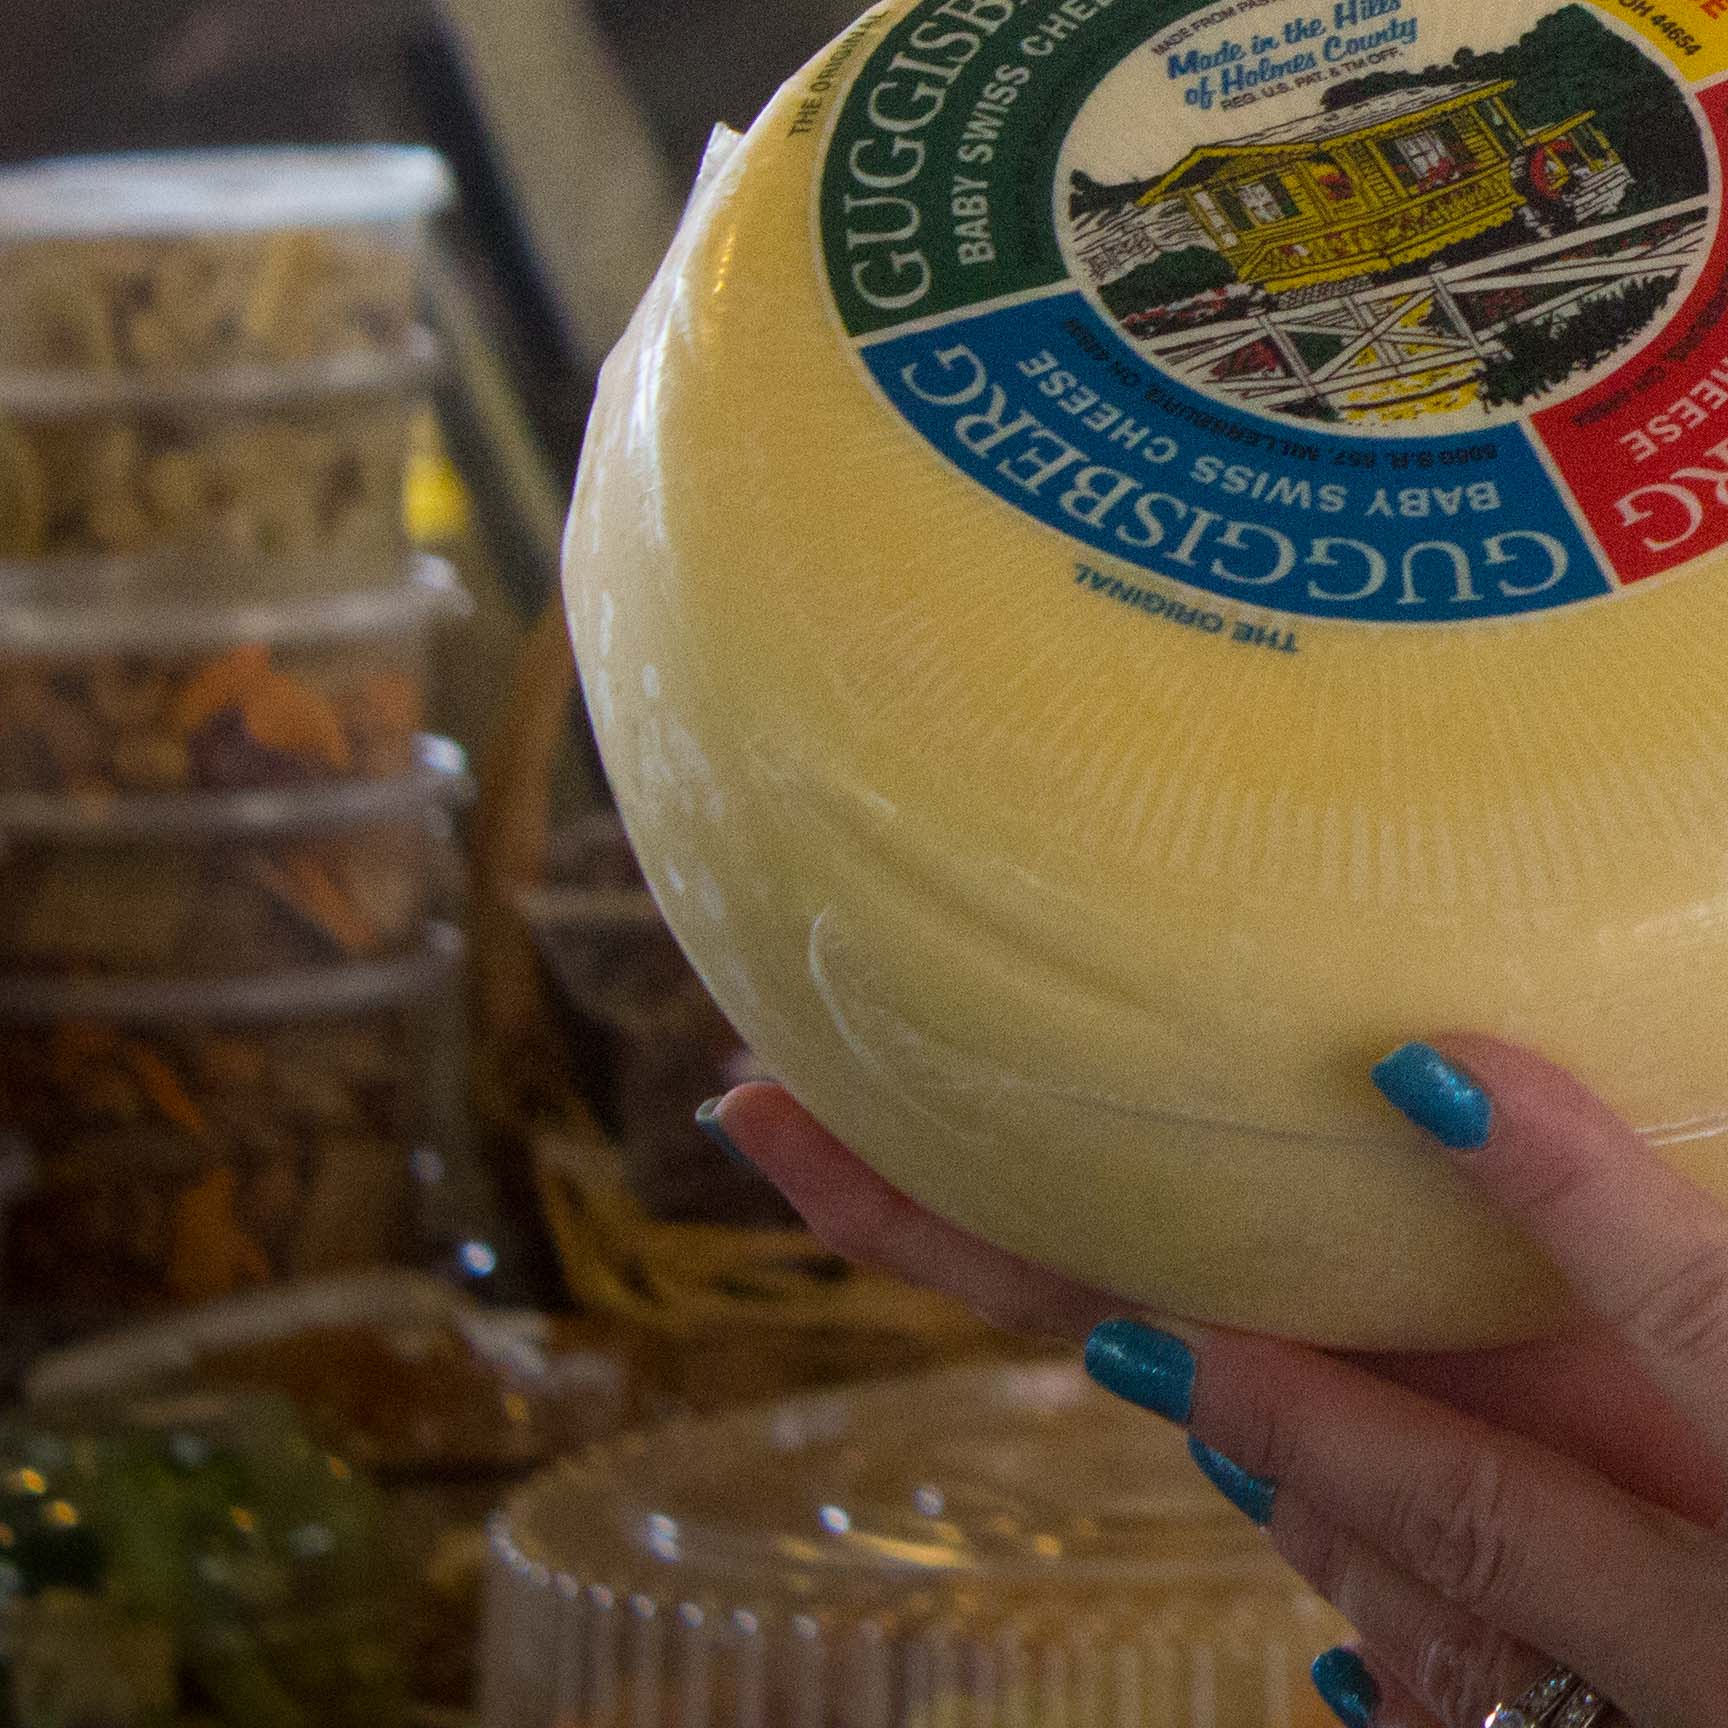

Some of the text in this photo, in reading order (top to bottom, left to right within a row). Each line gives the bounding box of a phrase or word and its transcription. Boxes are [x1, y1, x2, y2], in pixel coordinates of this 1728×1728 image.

[1151, 28, 1193, 56] MADE
[1191, 7, 1237, 32] FROM
[1168, 40, 1247, 79] Made
[1251, 34, 1279, 55] in
[1282, 17, 1326, 44] the
[1184, 17, 1418, 110] of Holmes County
[1651, 13, 1702, 56] 44654
[788, 98, 821, 138] THE
[957, 64, 1030, 165] SWISS
[952, 175, 997, 265] BABY
[904, 343, 1569, 604] GUGGISBERG
[1018, 352, 1501, 518] BABY SWISS CHEESE
[1073, 563, 1299, 655] THE ORIGINAL
